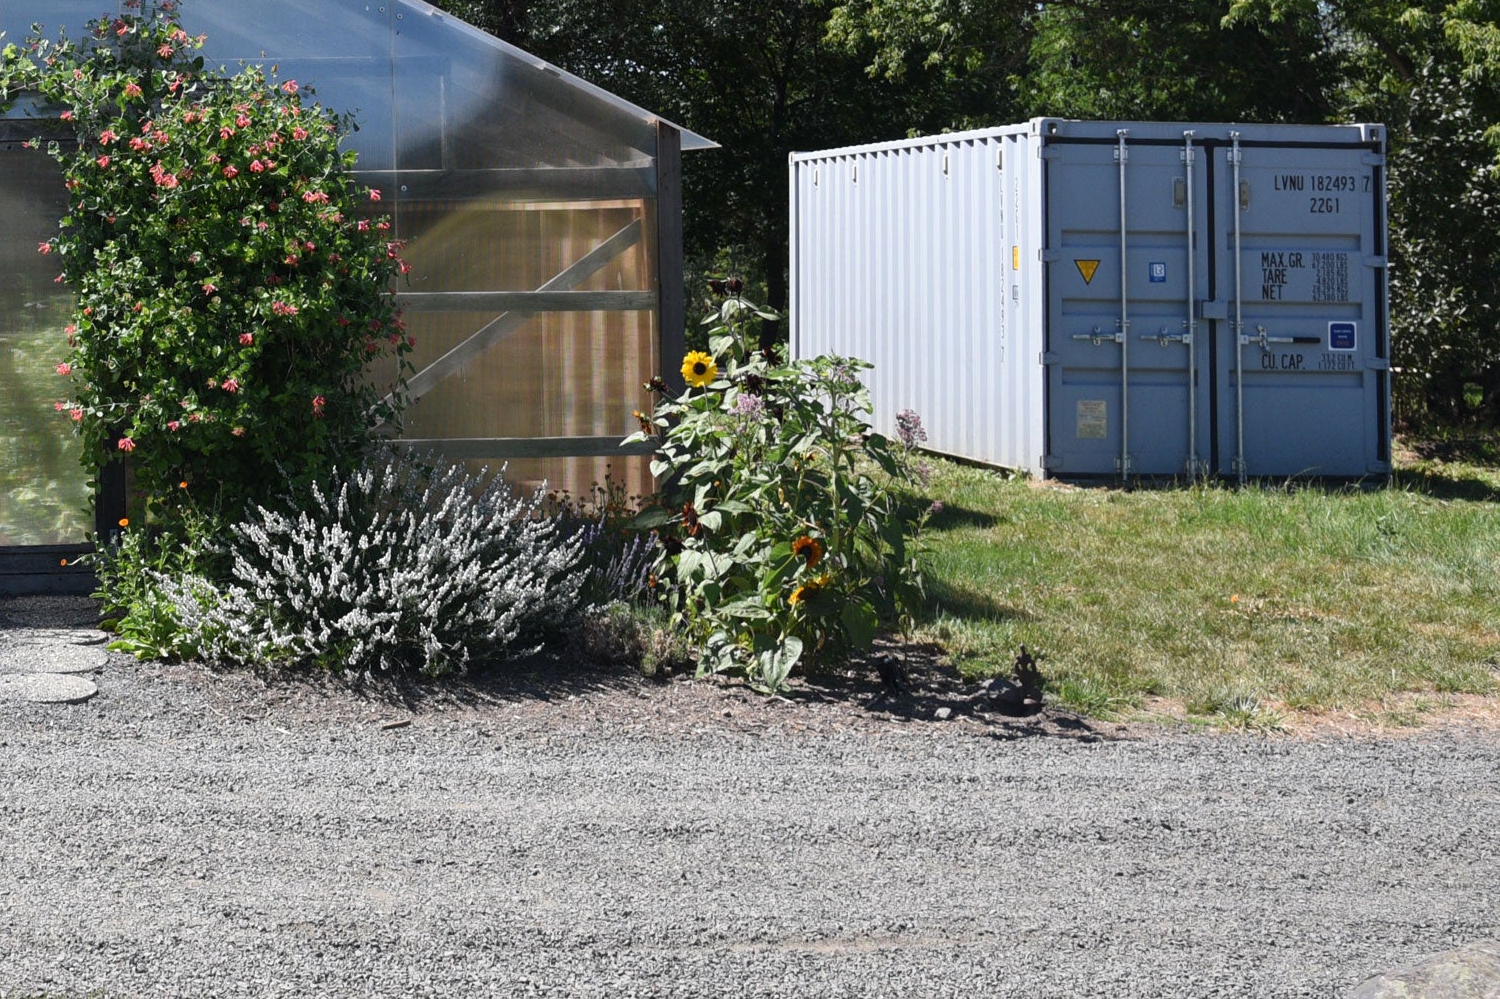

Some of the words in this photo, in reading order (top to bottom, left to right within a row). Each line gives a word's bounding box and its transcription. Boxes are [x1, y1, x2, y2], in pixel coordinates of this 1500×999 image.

[1274, 175, 1304, 192] LVNU
[1311, 176, 1356, 192] 182493
[1363, 176, 1370, 192] 7
[1310, 198, 1340, 213] 22G1
[1262, 268, 1288, 284] TARE
[1262, 284, 1283, 300] NET
[1261, 353, 1278, 369] CU.
[1281, 353, 1306, 369] CAP.
